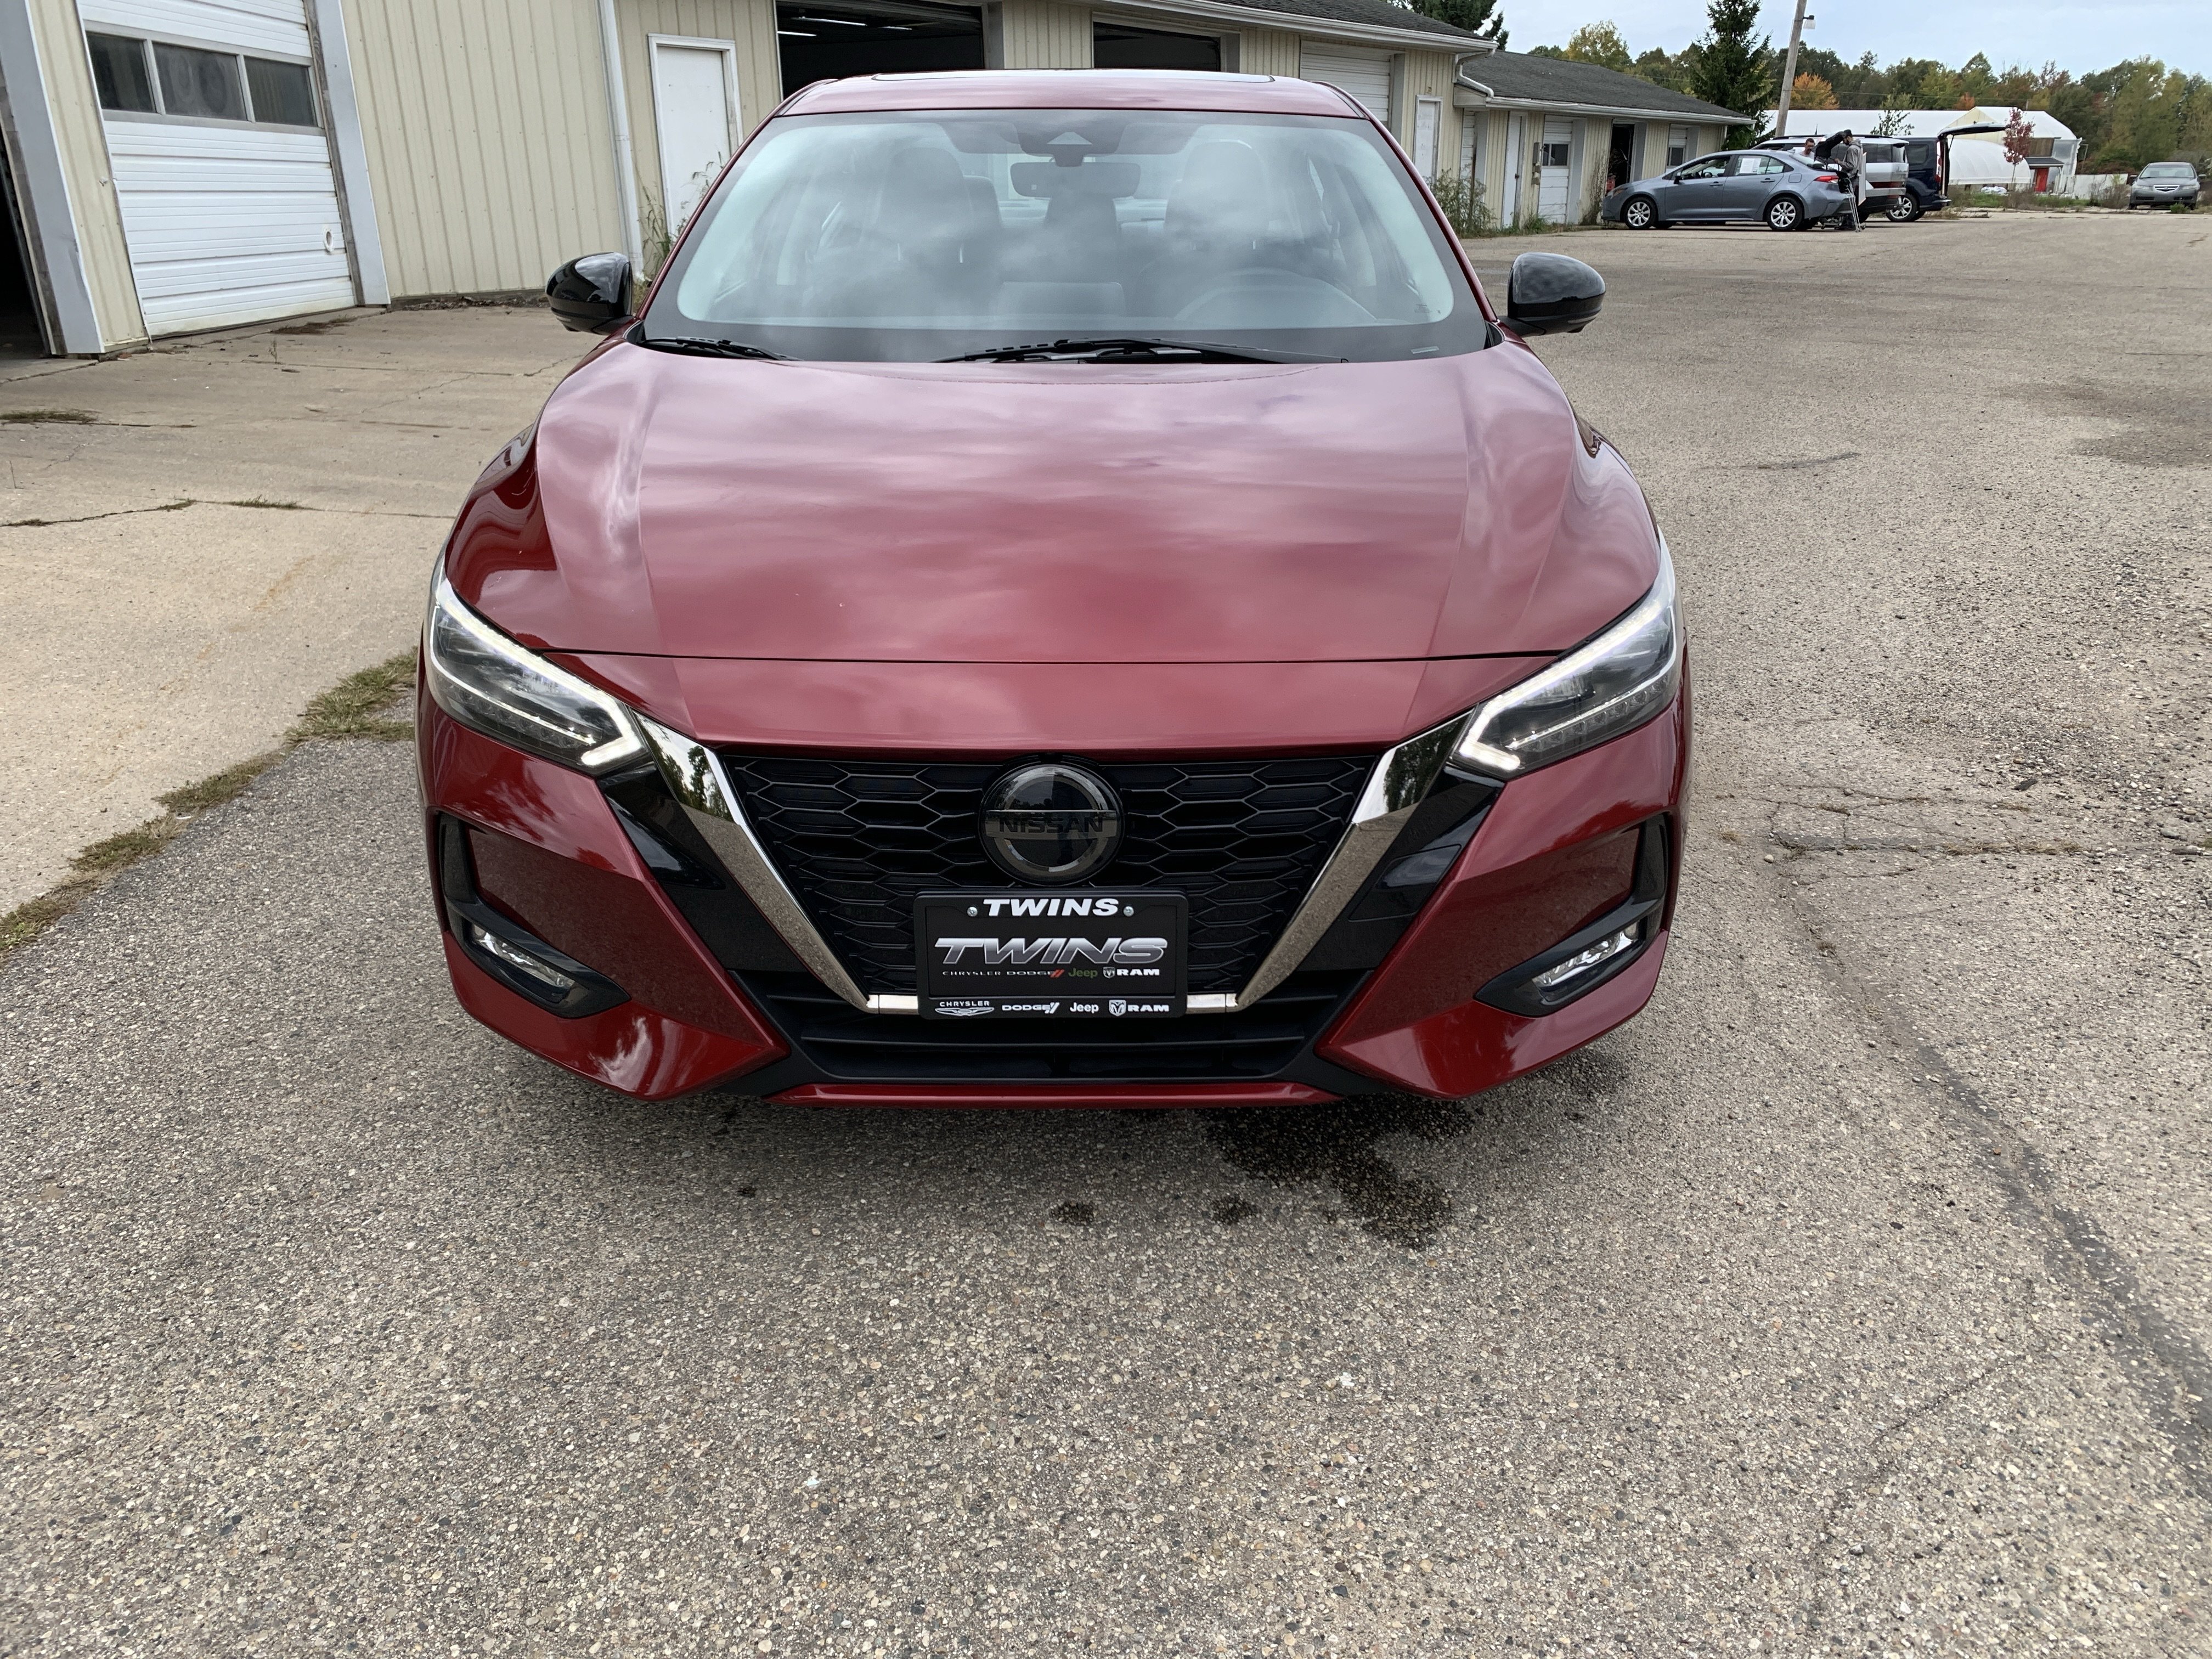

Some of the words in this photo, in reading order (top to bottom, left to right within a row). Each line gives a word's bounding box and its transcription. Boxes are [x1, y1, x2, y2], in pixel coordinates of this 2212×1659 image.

[999, 816, 1103, 833] NISSAN
[983, 898, 1119, 916] TWINS
[934, 938, 1168, 964] TWINS
[1068, 967, 1098, 979] Jeep
[1070, 1002, 1099, 1014] Jeep
[1127, 1004, 1170, 1012] RAM
